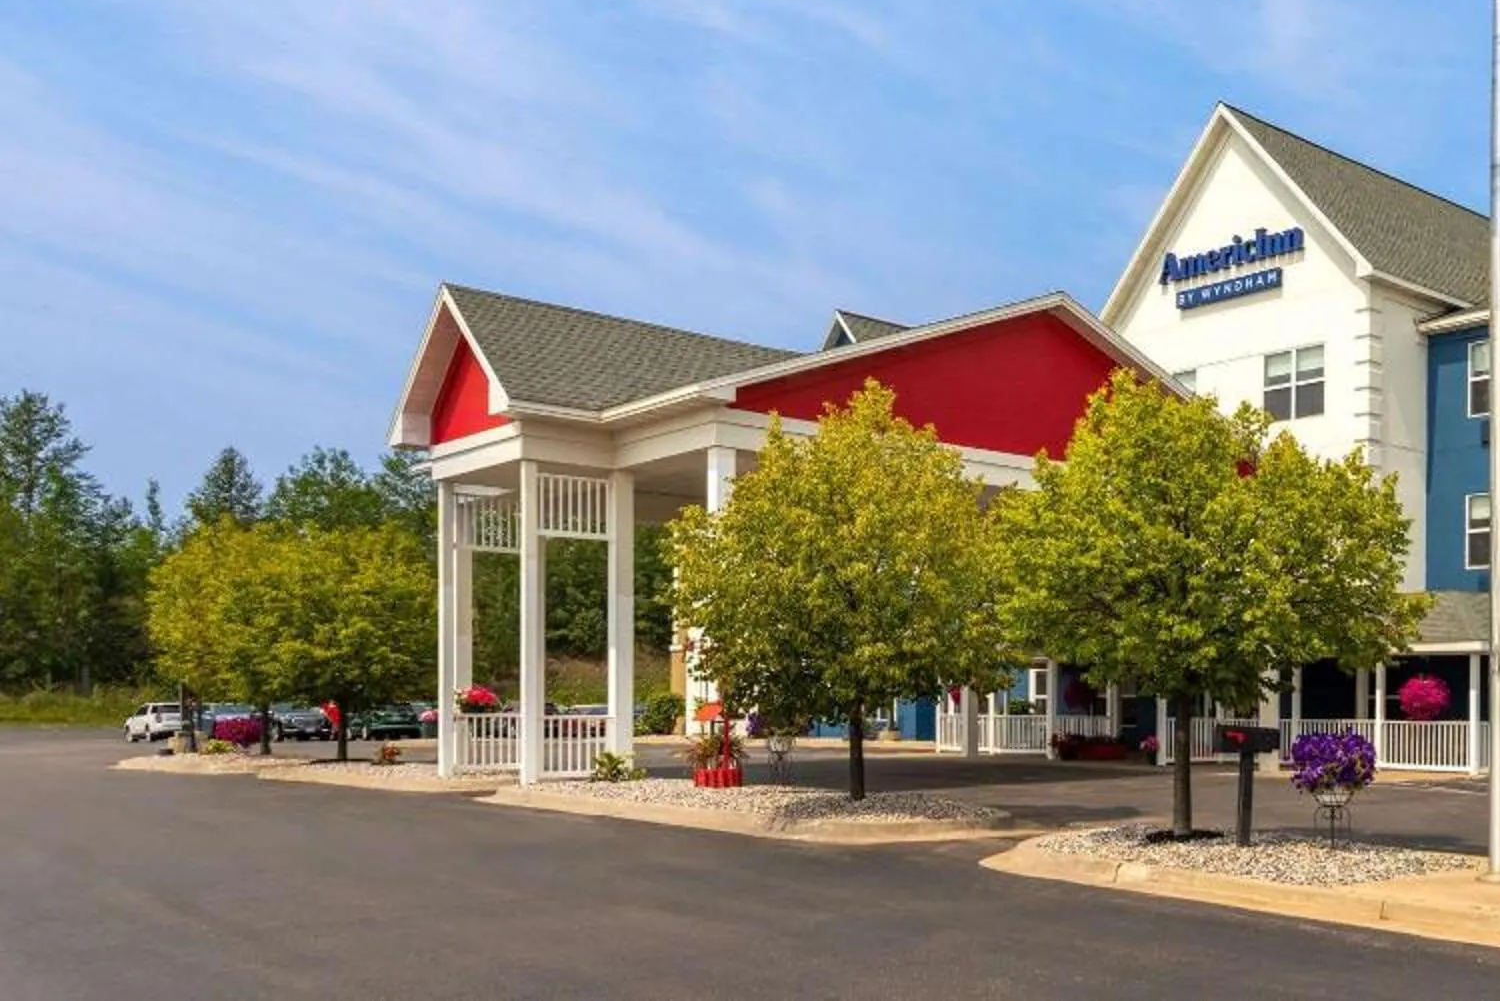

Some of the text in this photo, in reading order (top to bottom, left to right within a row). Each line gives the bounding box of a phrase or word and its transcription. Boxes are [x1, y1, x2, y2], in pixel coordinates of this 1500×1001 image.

[1160, 227, 1305, 285] AmericInn
[1178, 272, 1278, 305] BY WYNDHAM
